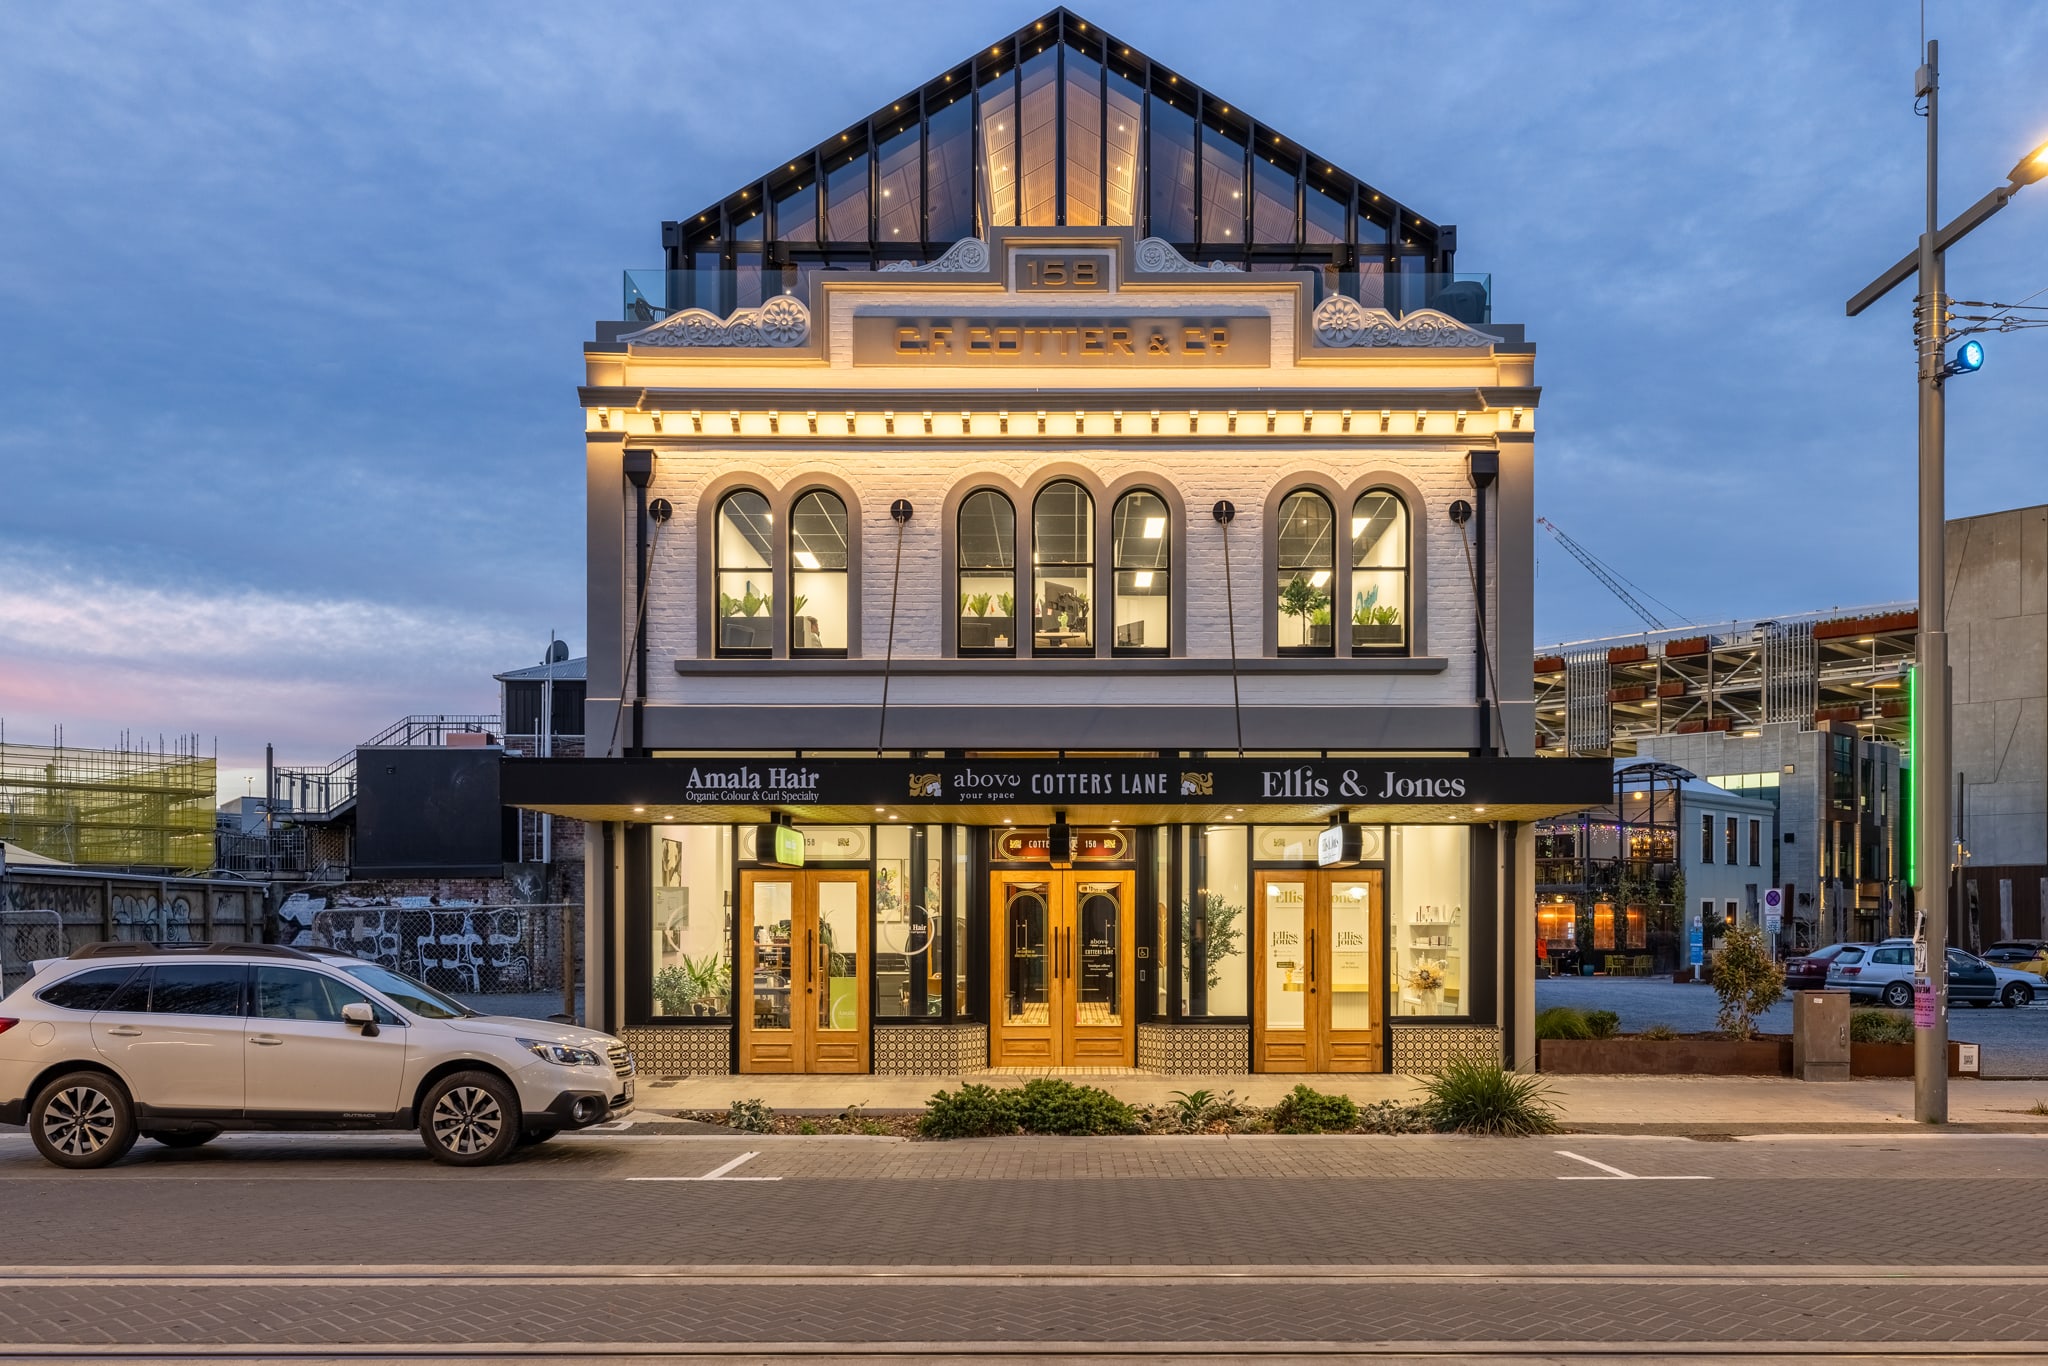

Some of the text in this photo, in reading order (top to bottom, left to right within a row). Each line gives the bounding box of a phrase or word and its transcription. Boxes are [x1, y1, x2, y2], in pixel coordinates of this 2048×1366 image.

[1026, 260, 1098, 286] 158
[966, 326, 1135, 356] COTTER
[1147, 333, 1170, 356] &
[686, 766, 820, 789] Amala Hair
[954, 768, 1020, 788] above
[1031, 773, 1168, 795] COTTERS LANE
[1261, 765, 1466, 799] Ellis & Jones
[686, 791, 819, 803] Organic Colour & Curl Specialty
[960, 792, 1015, 801] your space
[1028, 840, 1050, 849] COTTE
